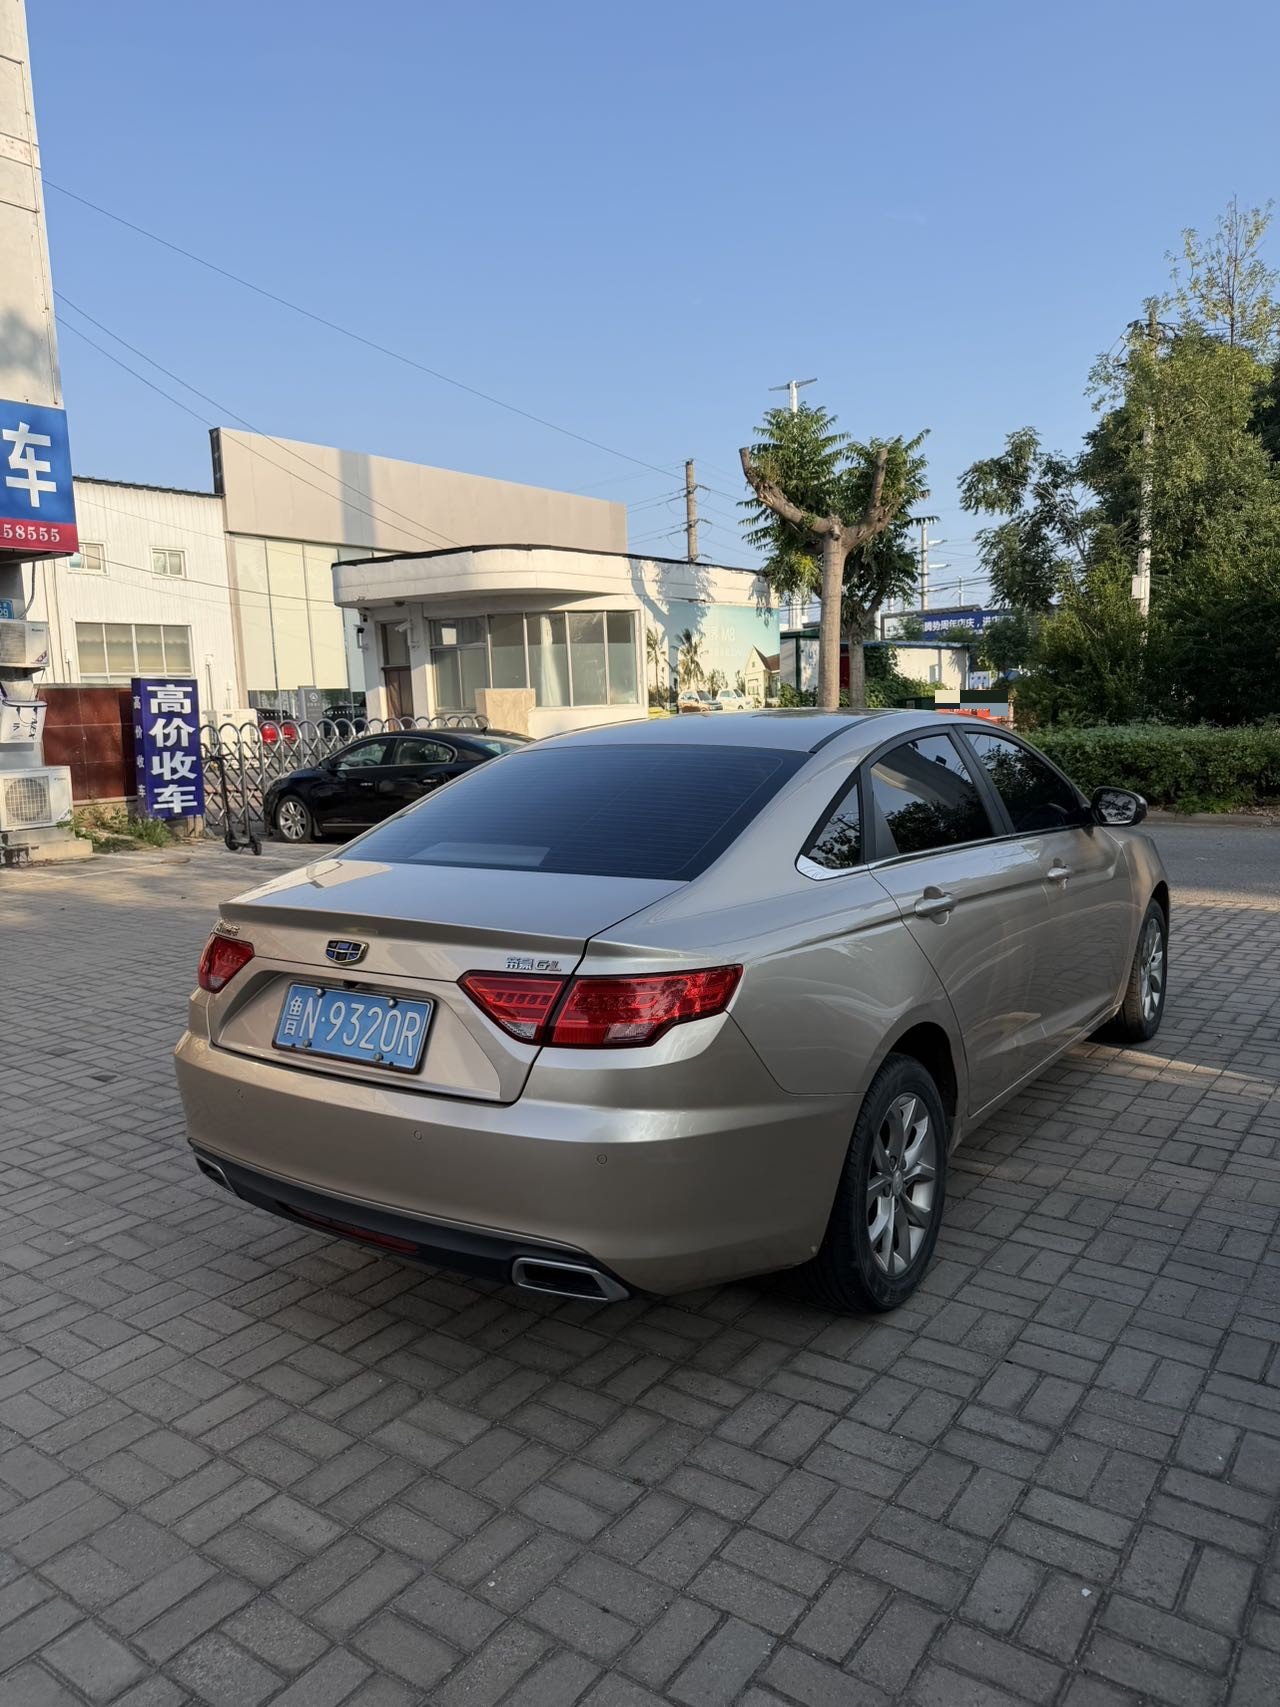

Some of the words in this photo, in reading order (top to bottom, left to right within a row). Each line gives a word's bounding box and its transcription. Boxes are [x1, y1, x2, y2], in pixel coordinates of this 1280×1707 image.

[2, 422, 56, 507] 车
[133, 695, 146, 797] 高价收车
[147, 684, 198, 813] 高价收车
